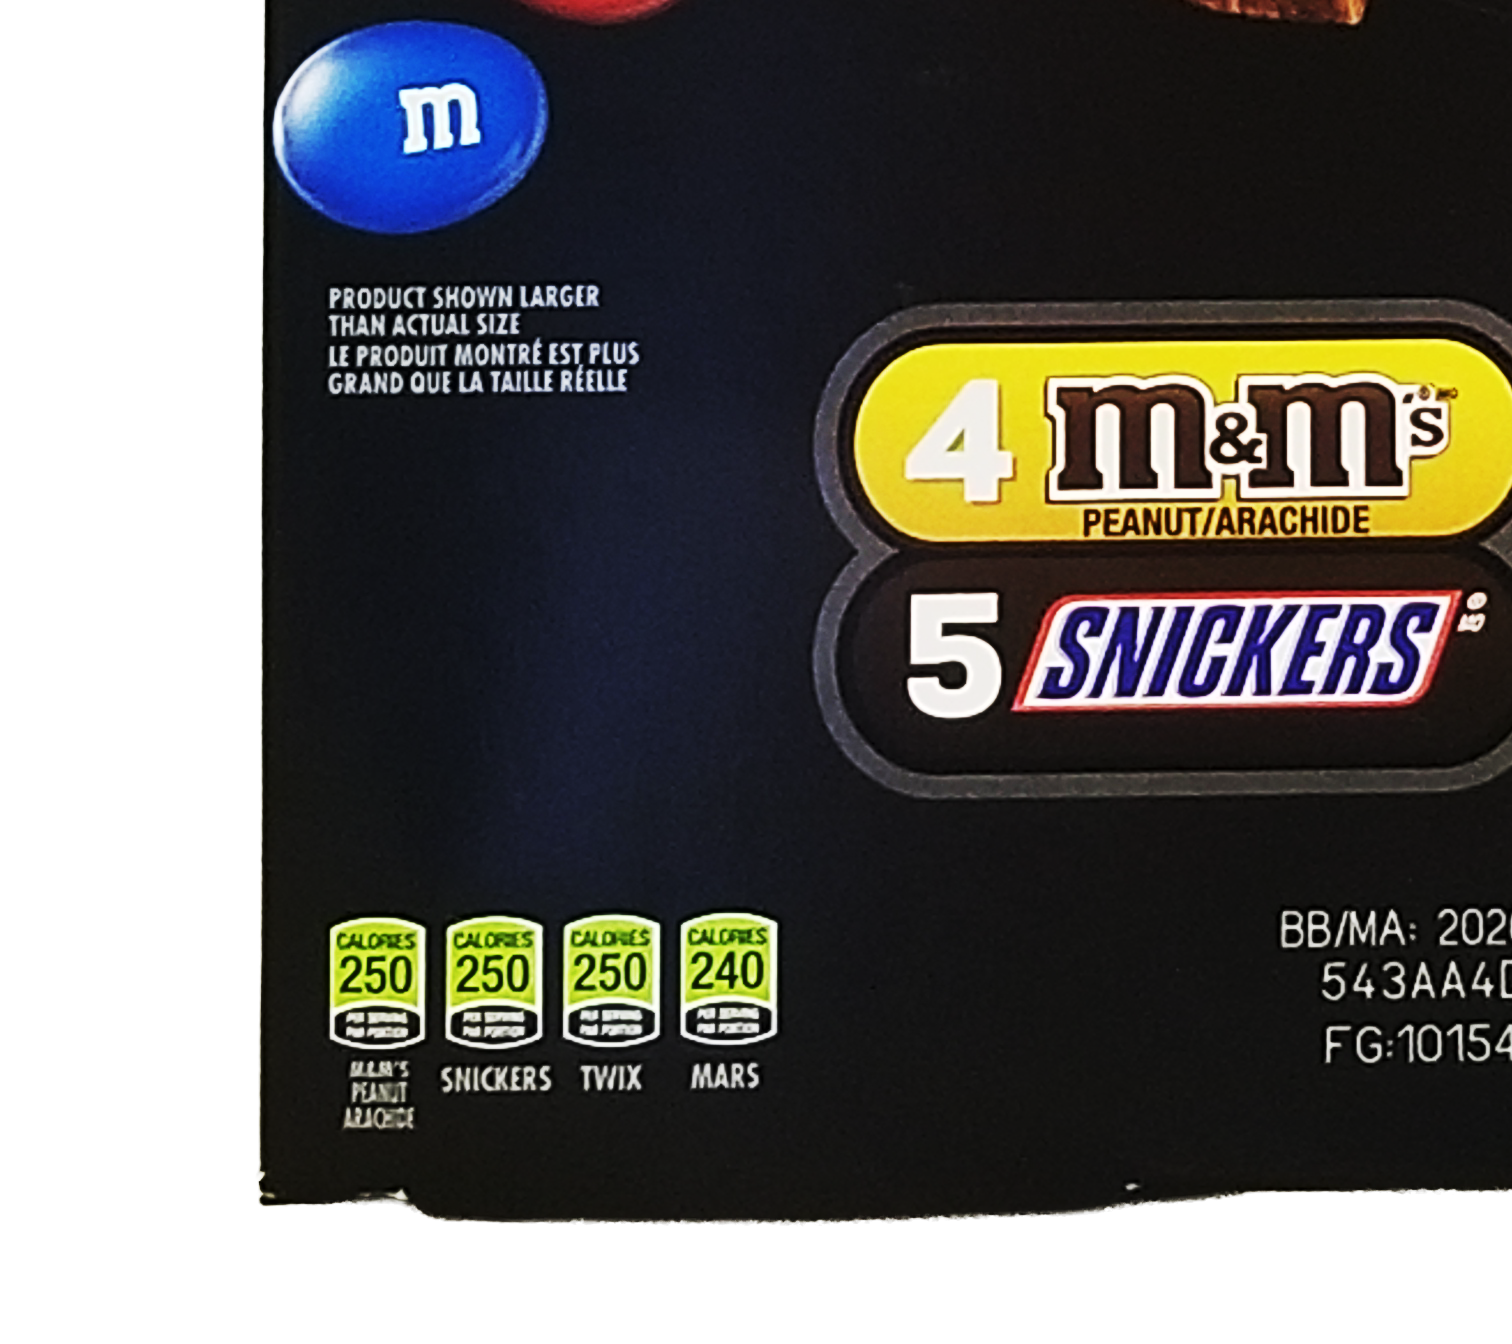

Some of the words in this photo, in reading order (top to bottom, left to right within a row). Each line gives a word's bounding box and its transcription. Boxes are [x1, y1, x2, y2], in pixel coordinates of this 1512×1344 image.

[328, 286, 427, 309] PRODUCT
[433, 285, 513, 309] SHOWN
[519, 284, 600, 308] LARGER
[328, 314, 386, 337] THAN
[392, 313, 470, 336] ACTUAL
[476, 312, 521, 336] SIZE
[328, 343, 349, 367] LE
[356, 343, 448, 367] PRODUIT
[454, 336, 543, 367] MONTRÉ
[549, 342, 584, 365] EST
[589, 341, 641, 365] PLUS
[328, 372, 404, 395] GRAND
[410, 370, 452, 394] QUE
[458, 370, 484, 393] LA
[490, 369, 554, 393] TAILLE
[560, 364, 628, 393] RÉELLE
[904, 378, 1015, 503] 4
[1082, 504, 1371, 538] PEANUT/ARACHIDE
[906, 592, 1003, 720] 5
[1034, 600, 1443, 701] SNICKERS
[1280, 909, 1418, 949] BB/MA:
[339, 954, 413, 994] 250
[455, 953, 530, 993] 250
[573, 951, 647, 992] 250
[690, 949, 765, 990] 240
[440, 1064, 552, 1094] SNICKERS
[580, 1063, 643, 1092] TWIX
[690, 1062, 760, 1090] MARS
